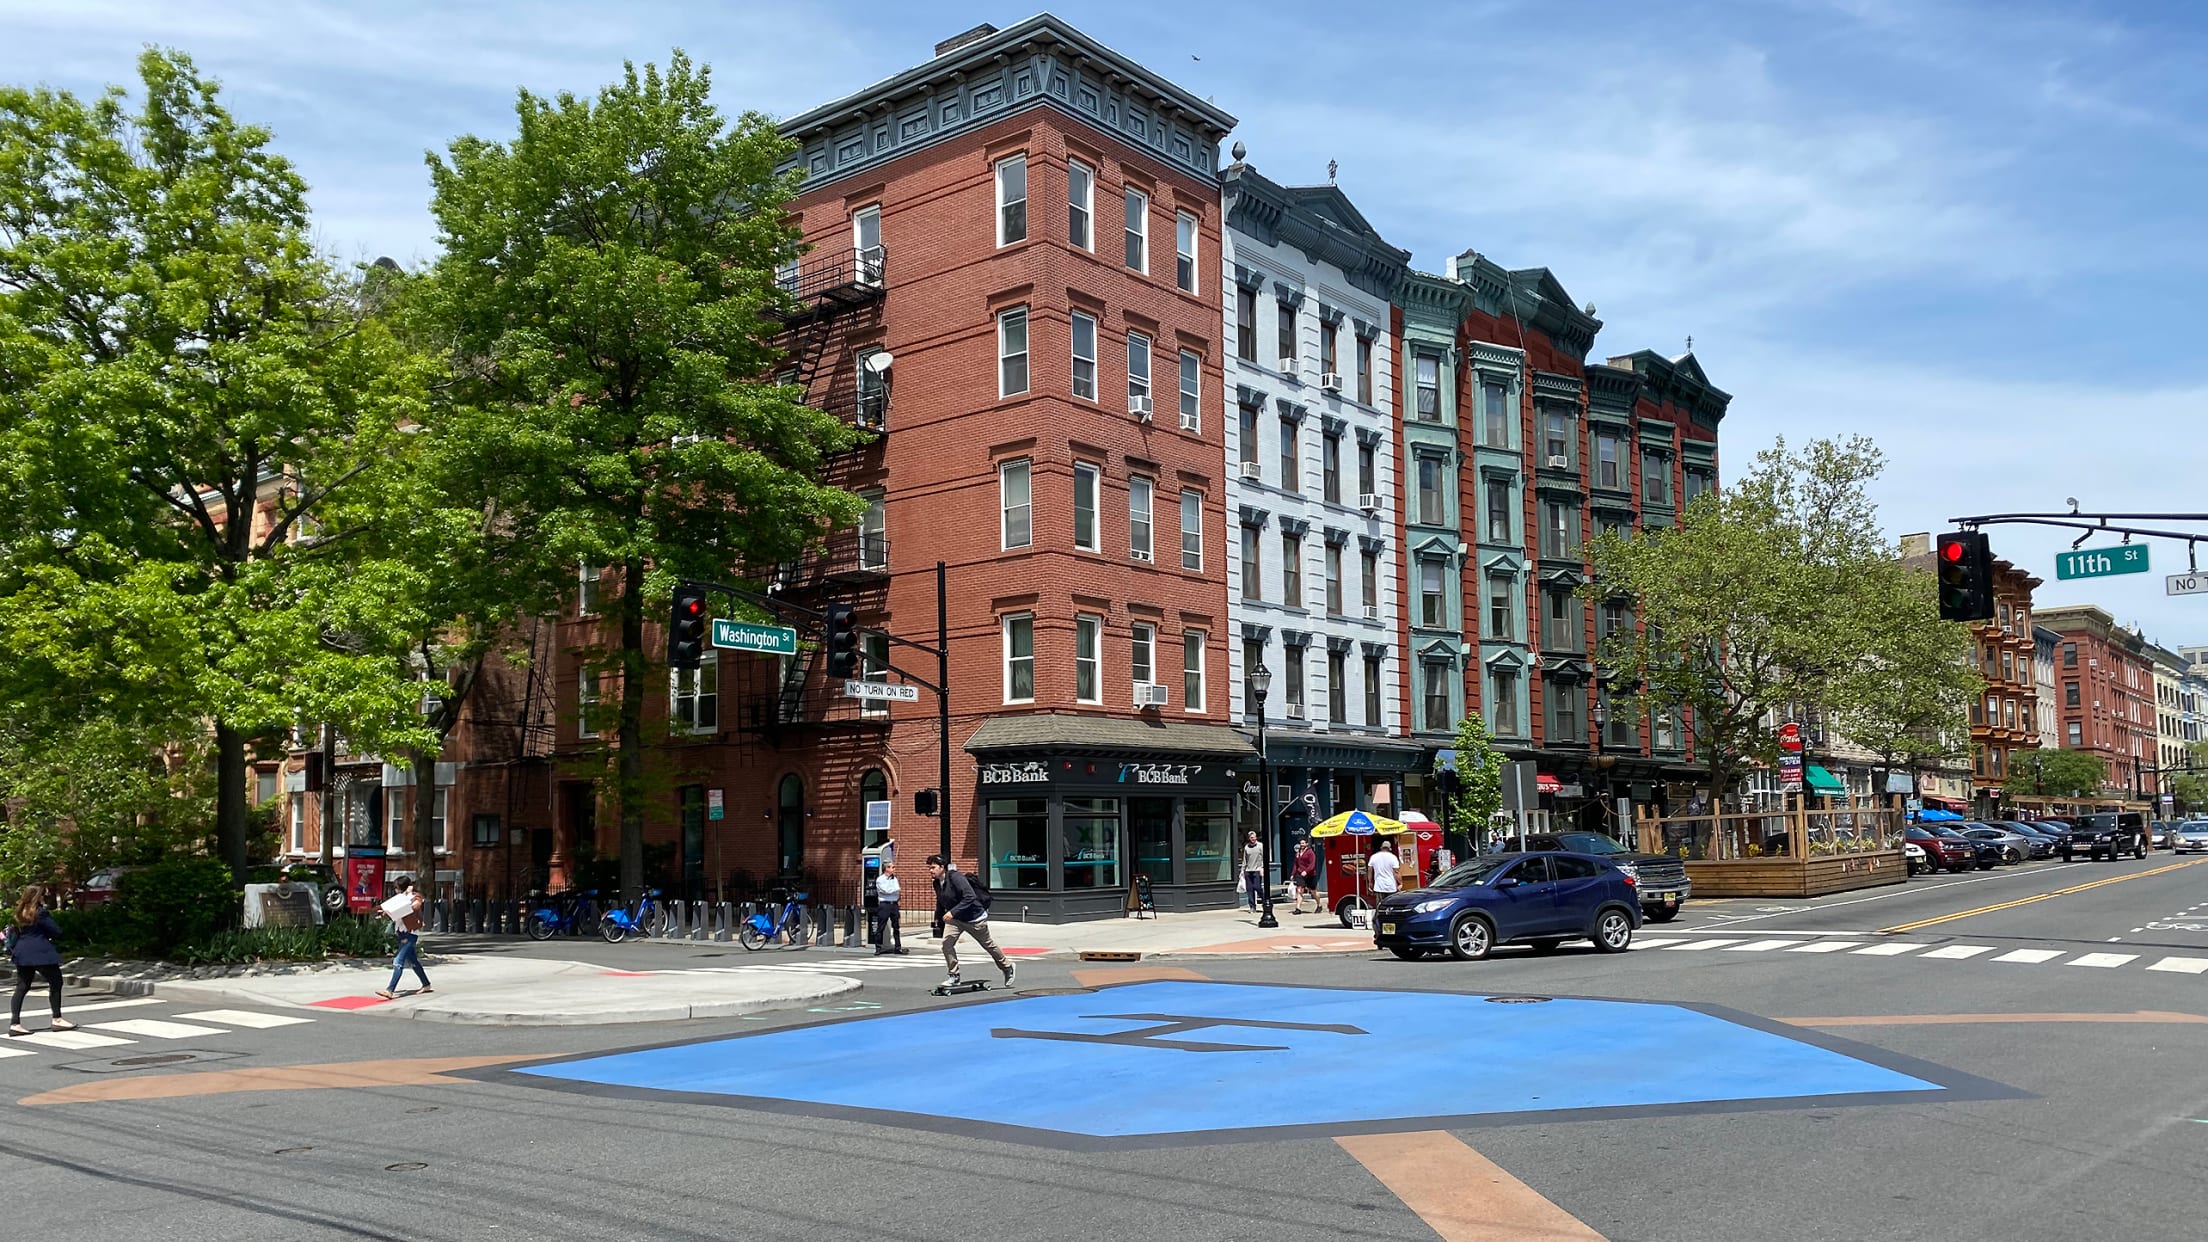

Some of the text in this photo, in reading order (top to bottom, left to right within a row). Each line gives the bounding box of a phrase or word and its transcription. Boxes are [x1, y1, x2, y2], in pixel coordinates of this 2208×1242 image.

[2067, 550, 2138, 575] 11th St
[2175, 578, 2197, 591] NO
[720, 624, 790, 648] Washington St
[850, 684, 914, 698] NO TURN ON RED
